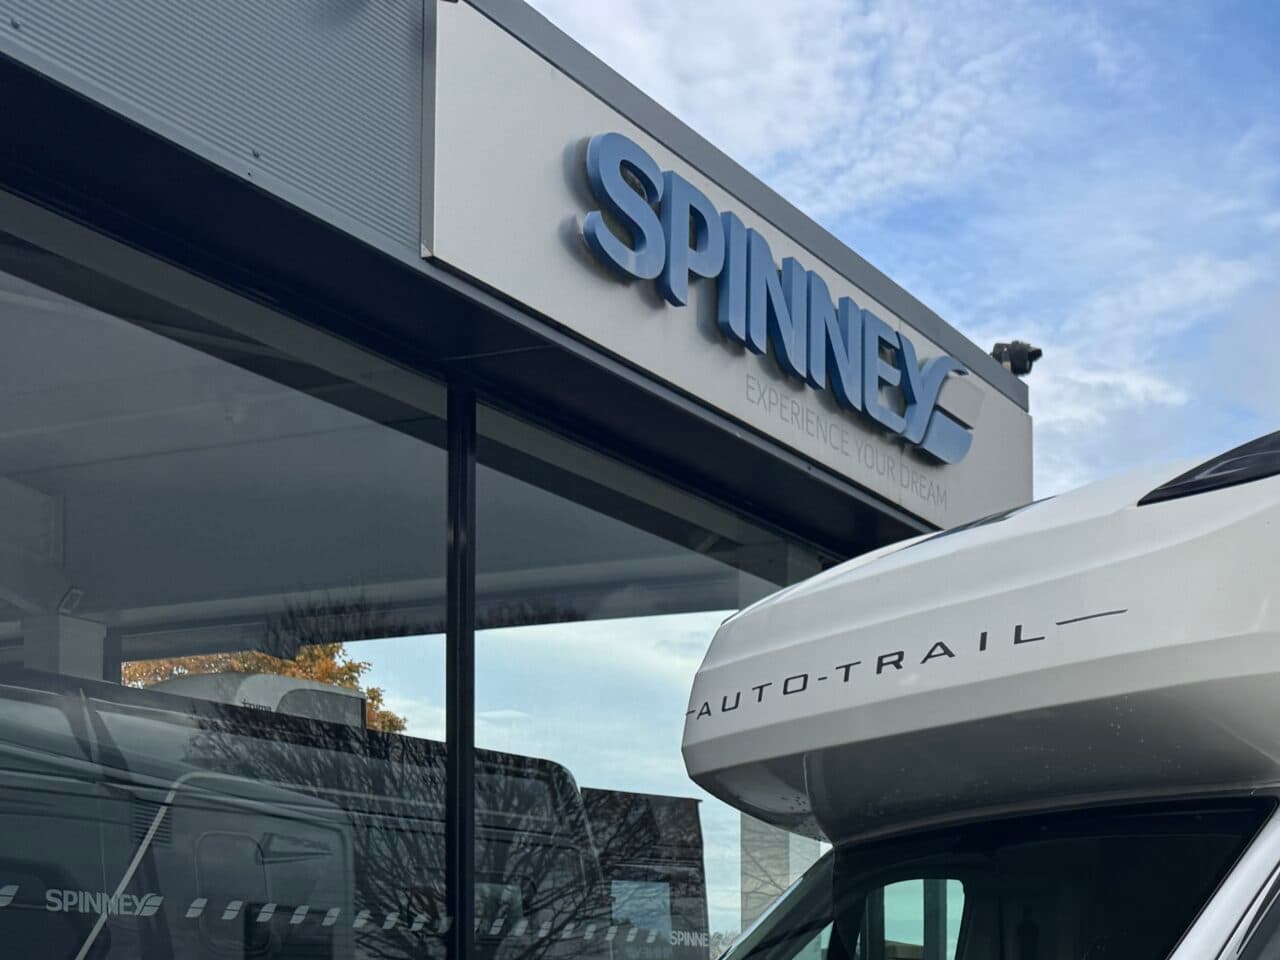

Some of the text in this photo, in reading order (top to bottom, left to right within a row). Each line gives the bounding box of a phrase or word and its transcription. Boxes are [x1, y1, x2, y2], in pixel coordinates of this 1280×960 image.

[583, 131, 974, 465] SPINNEY
[745, 374, 949, 512] EXPERIENCE YOUR DREAM
[696, 624, 1046, 720] AUTO-TRAIL
[45, 889, 161, 917] SPINNEY
